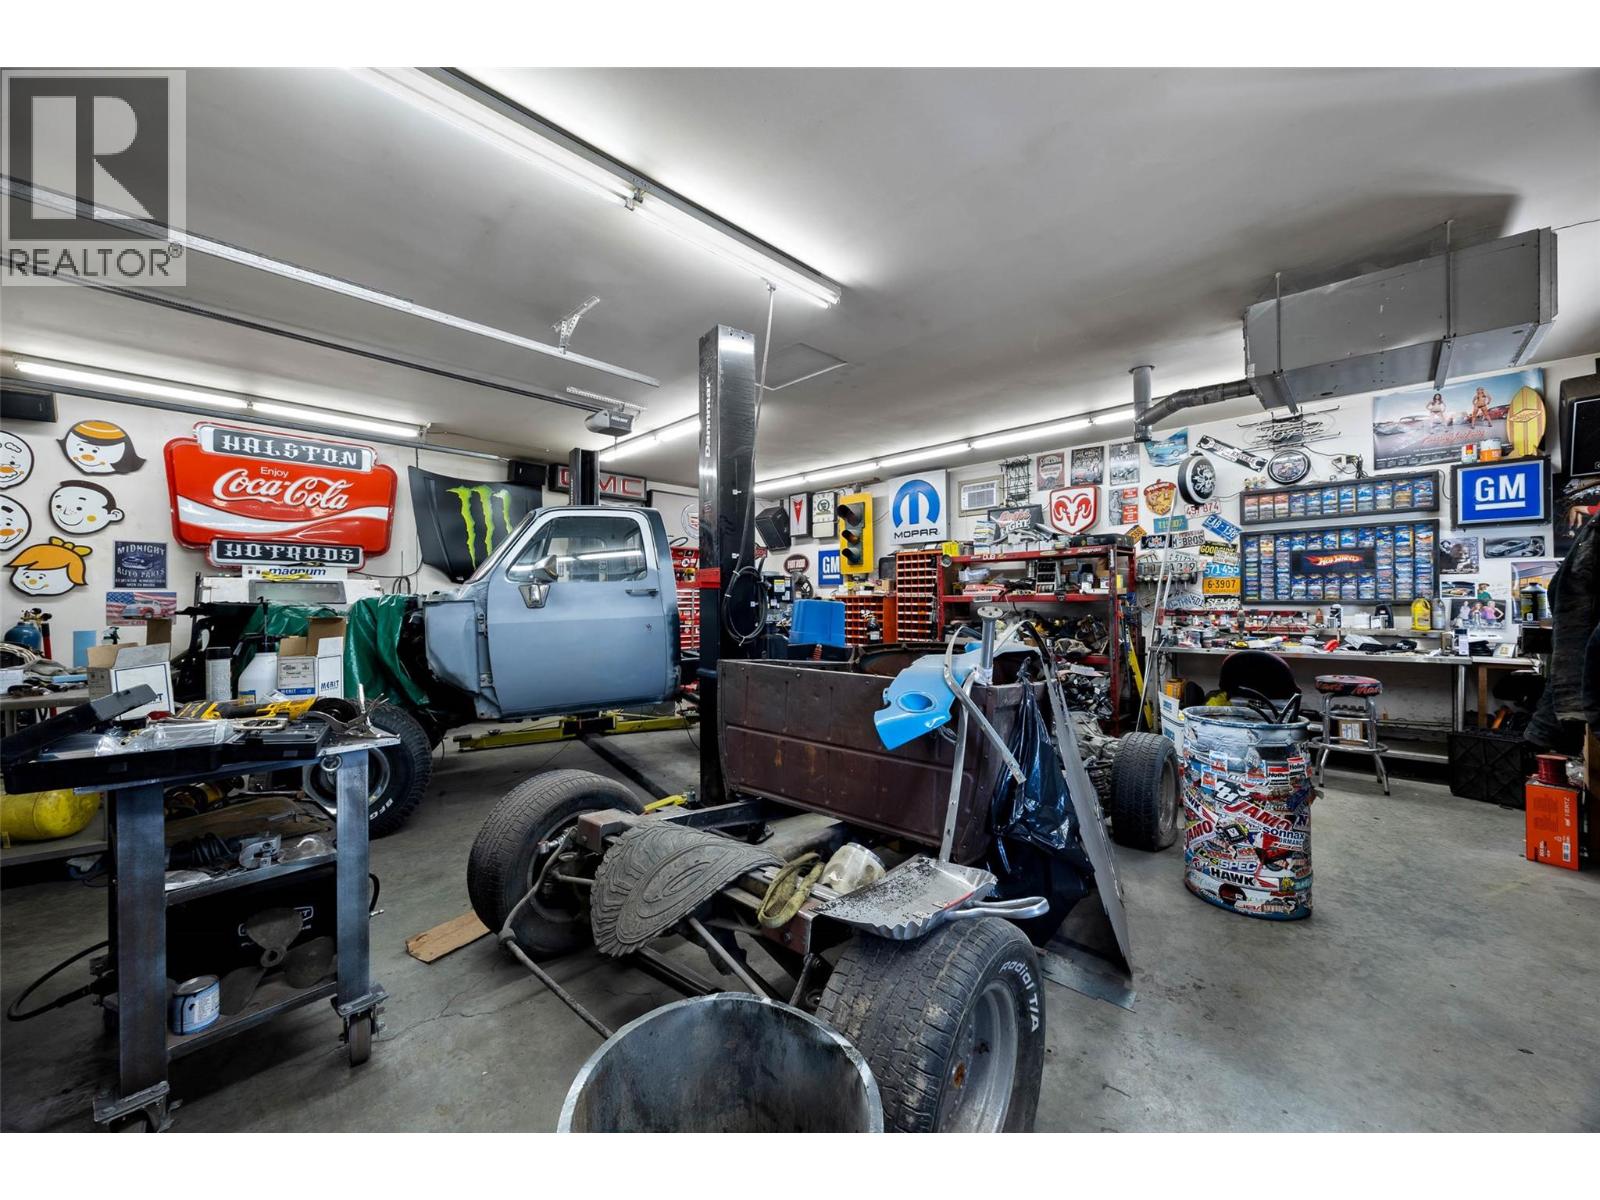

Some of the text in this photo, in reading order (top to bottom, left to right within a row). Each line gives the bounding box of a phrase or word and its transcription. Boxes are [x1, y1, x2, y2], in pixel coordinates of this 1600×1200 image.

[221, 434, 357, 466] HALSTON
[260, 467, 289, 477] Enjoy
[212, 468, 355, 510] Coca-Cola
[1474, 473, 1526, 502] GM
[893, 528, 938, 539] MOPAR
[117, 544, 166, 555] MIDNIGHT
[822, 555, 840, 573] GM
[117, 566, 165, 578] AUTO PARTS
[1207, 579, 1236, 588] 6-3907
[1223, 800, 1292, 831] JAMO
[1262, 827, 1306, 840] sonnax
[1219, 860, 1258, 872] SPEC
[1210, 867, 1255, 887] HAWK
